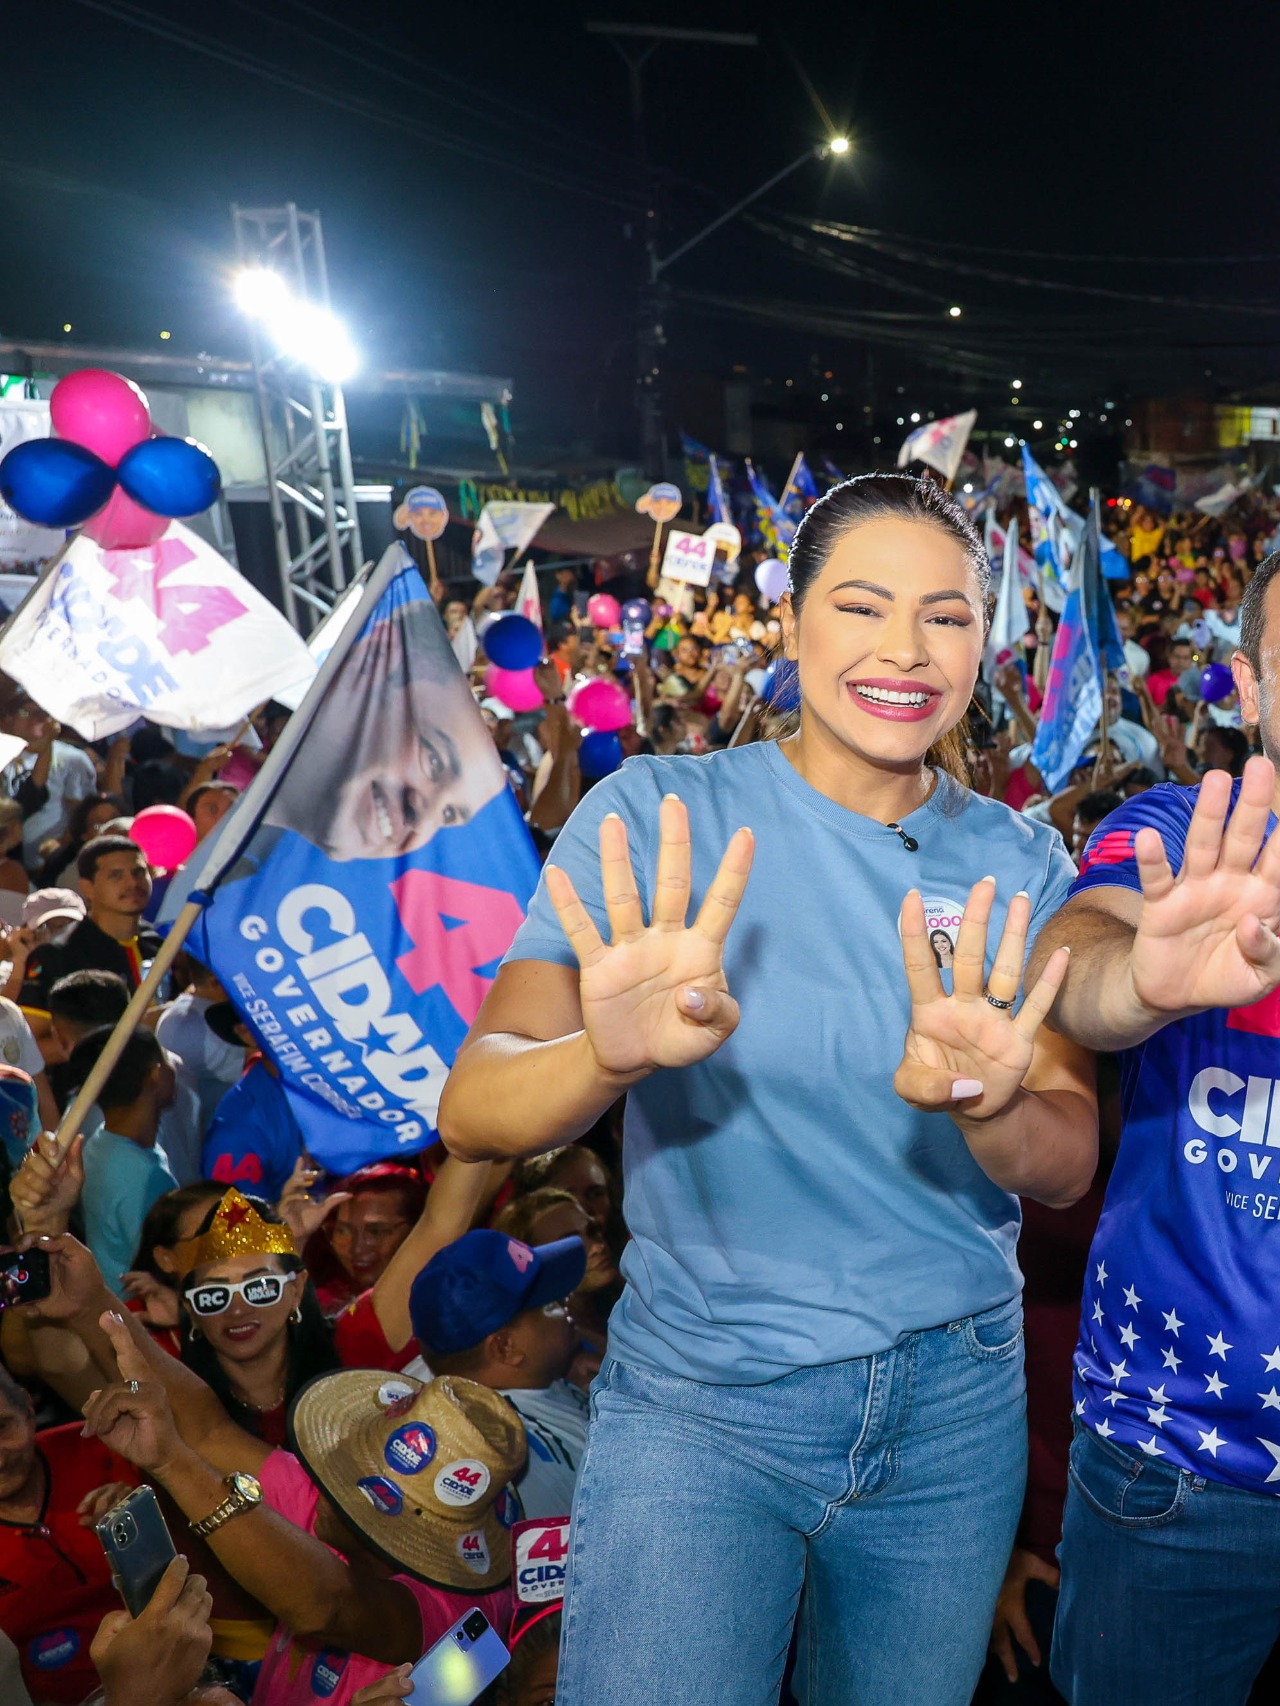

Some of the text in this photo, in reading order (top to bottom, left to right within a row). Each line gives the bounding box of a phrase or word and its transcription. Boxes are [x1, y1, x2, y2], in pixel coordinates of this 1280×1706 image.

[676, 538, 706, 558] 44
[239, 914, 423, 1144] GOVERNADOR
[245, 997, 311, 1075] SERAFIM
[212, 1153, 264, 1184] 44
[1225, 1190, 1250, 1211] VICE
[199, 1291, 225, 1307] RC
[392, 1439, 422, 1463] CIDADE
[442, 1477, 475, 1496] CIDADE
[452, 1466, 482, 1487] 44
[462, 1535, 480, 1552] 44
[527, 1528, 569, 1562] 4
